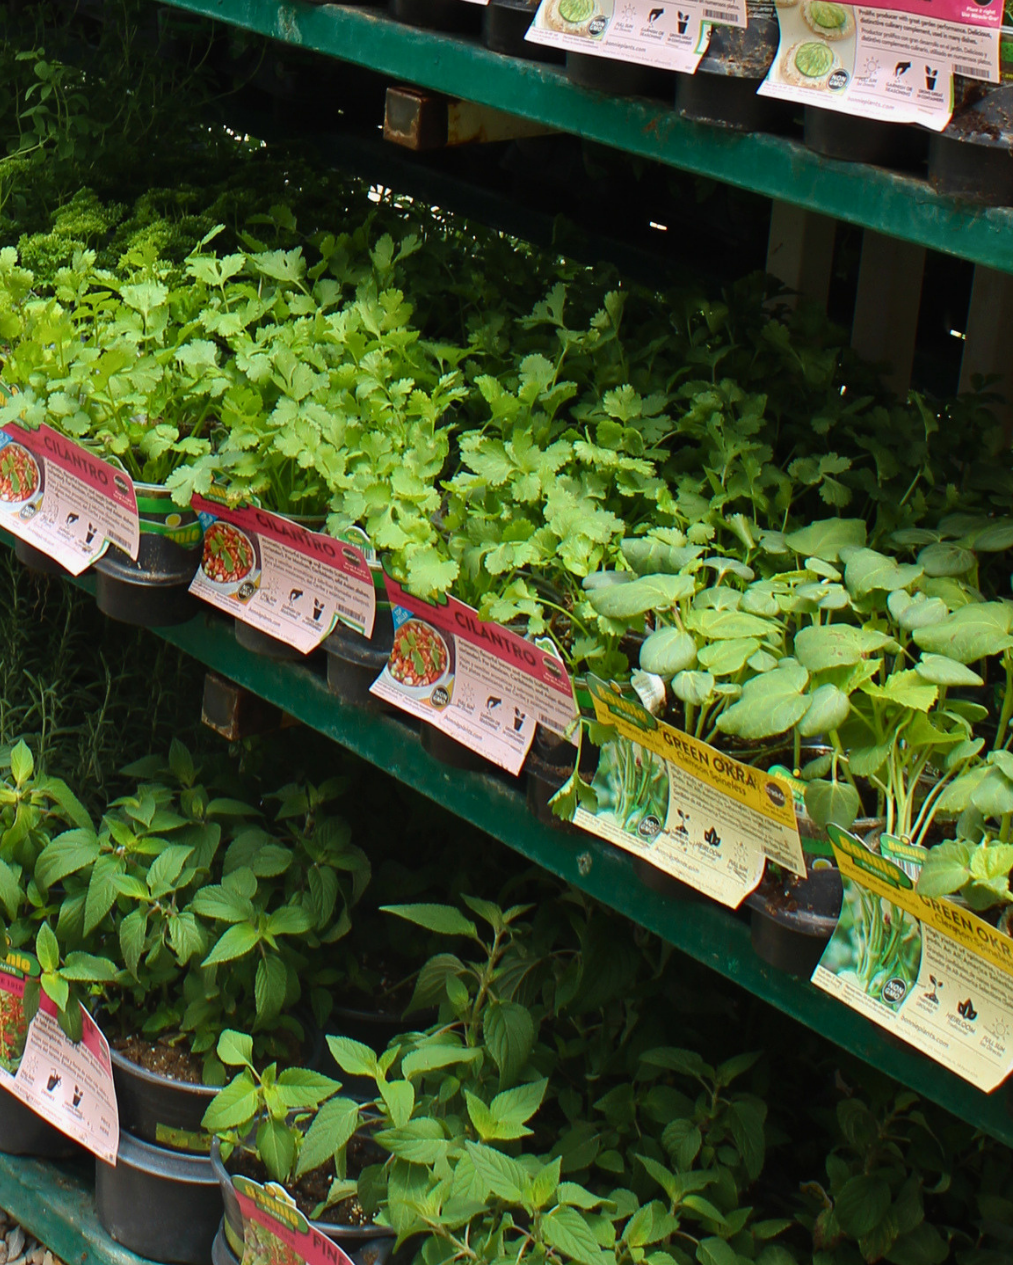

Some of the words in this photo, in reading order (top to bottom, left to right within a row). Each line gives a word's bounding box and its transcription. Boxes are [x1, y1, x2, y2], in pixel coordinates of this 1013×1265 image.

[831, 74, 847, 82] NON
[44, 435, 109, 486] CILANTRO
[255, 512, 336, 558] CILANTRO
[454, 611, 537, 667] CILANTRO
[663, 731, 710, 766] GREEN
[713, 757, 757, 790] OKRA
[839, 835, 900, 881] Bonnie
[888, 841, 927, 860] Bonnie
[919, 893, 974, 934] GREEN
[884, 987, 900, 1000] GMO
[889, 981, 905, 995] NON
[946, 1012, 976, 1034] HEIRLOOM
[244, 1184, 299, 1228] Bonnie
